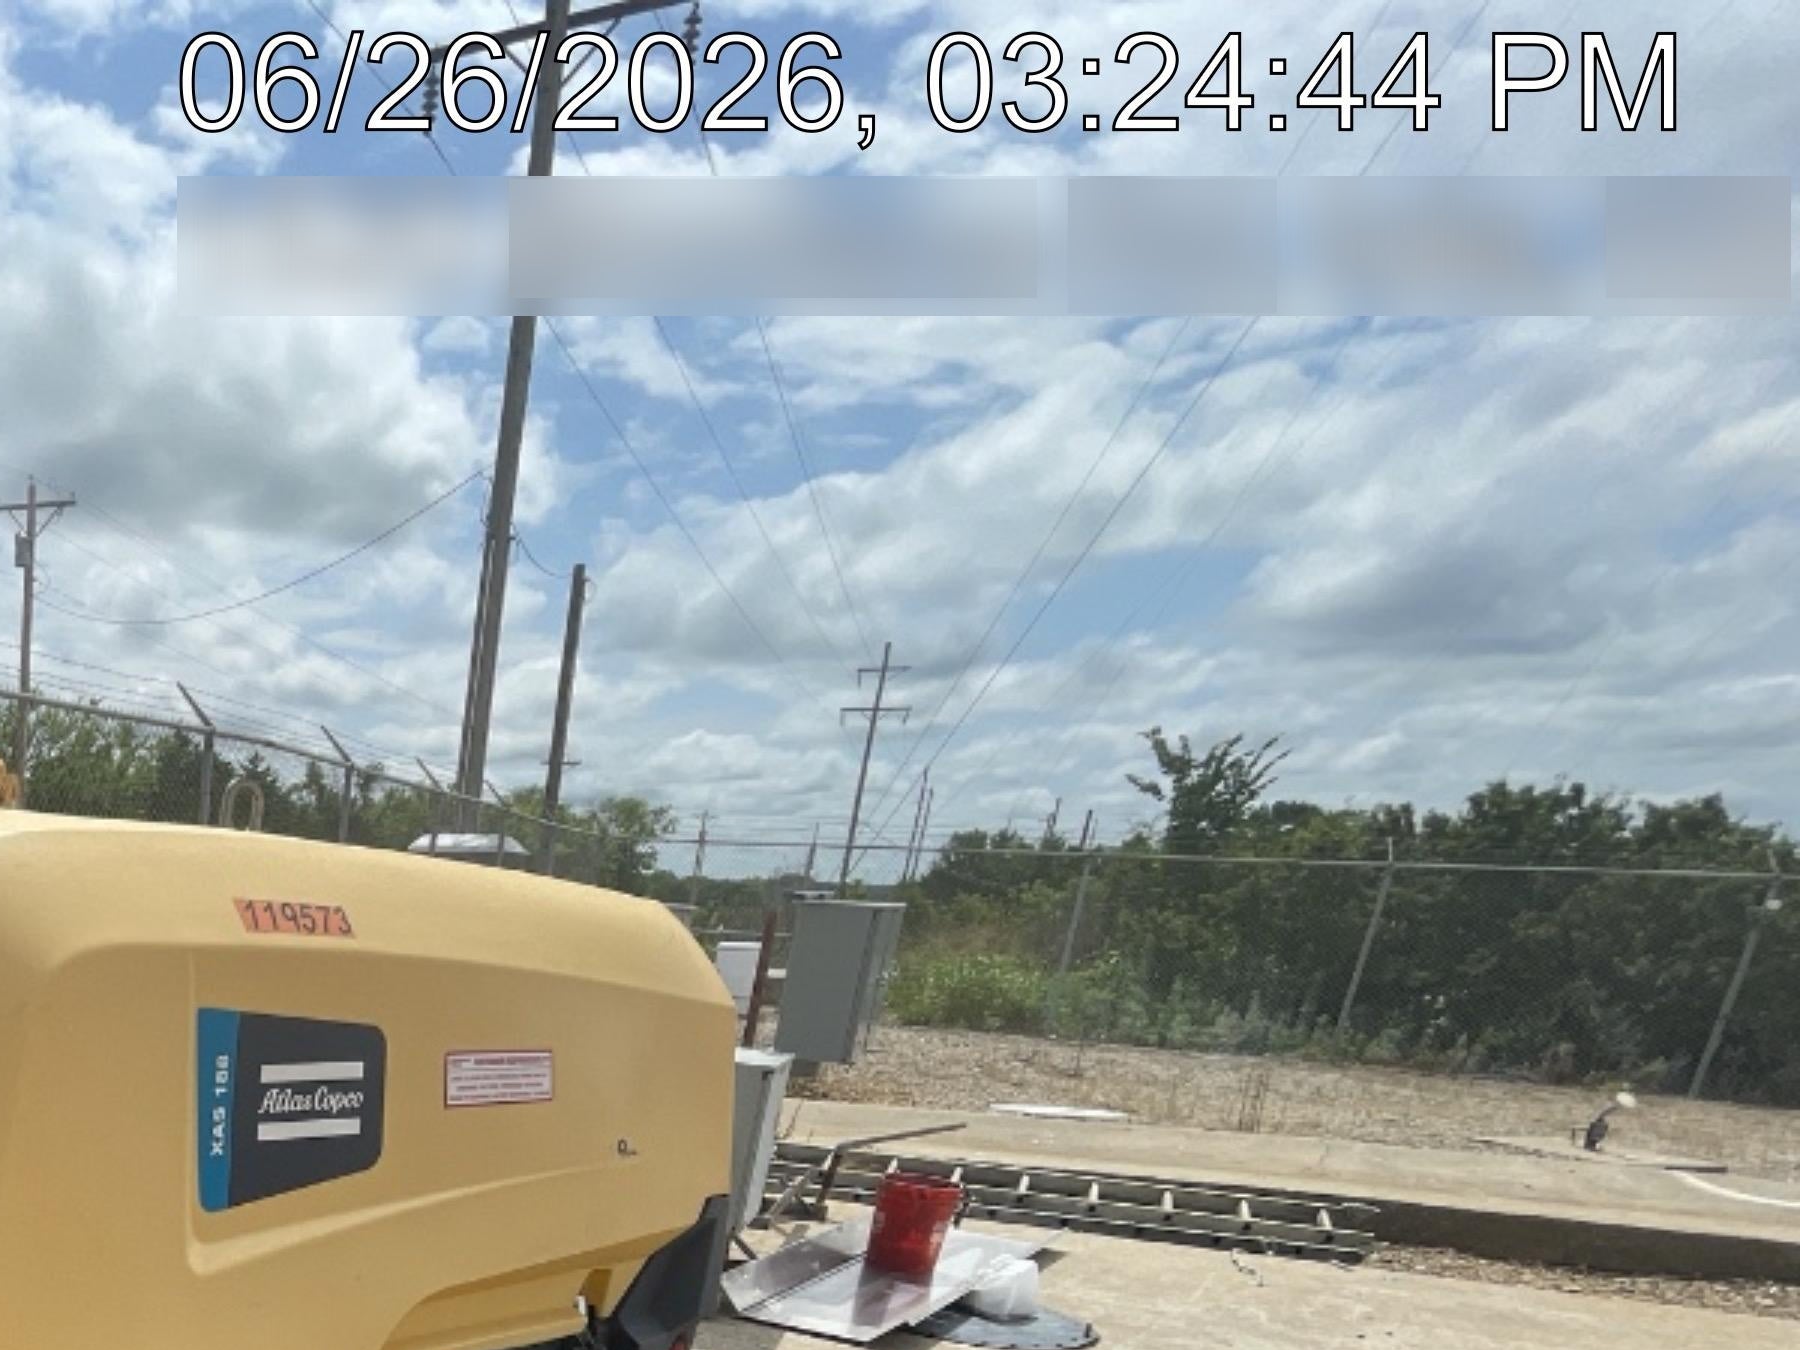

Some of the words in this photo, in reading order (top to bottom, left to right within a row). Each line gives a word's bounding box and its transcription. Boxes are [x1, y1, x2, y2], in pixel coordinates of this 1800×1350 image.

[243, 899, 354, 936] 119573
[257, 1087, 313, 1115] Atlas
[314, 1085, 364, 1114] Copco
[210, 1106, 226, 1156] XAS
